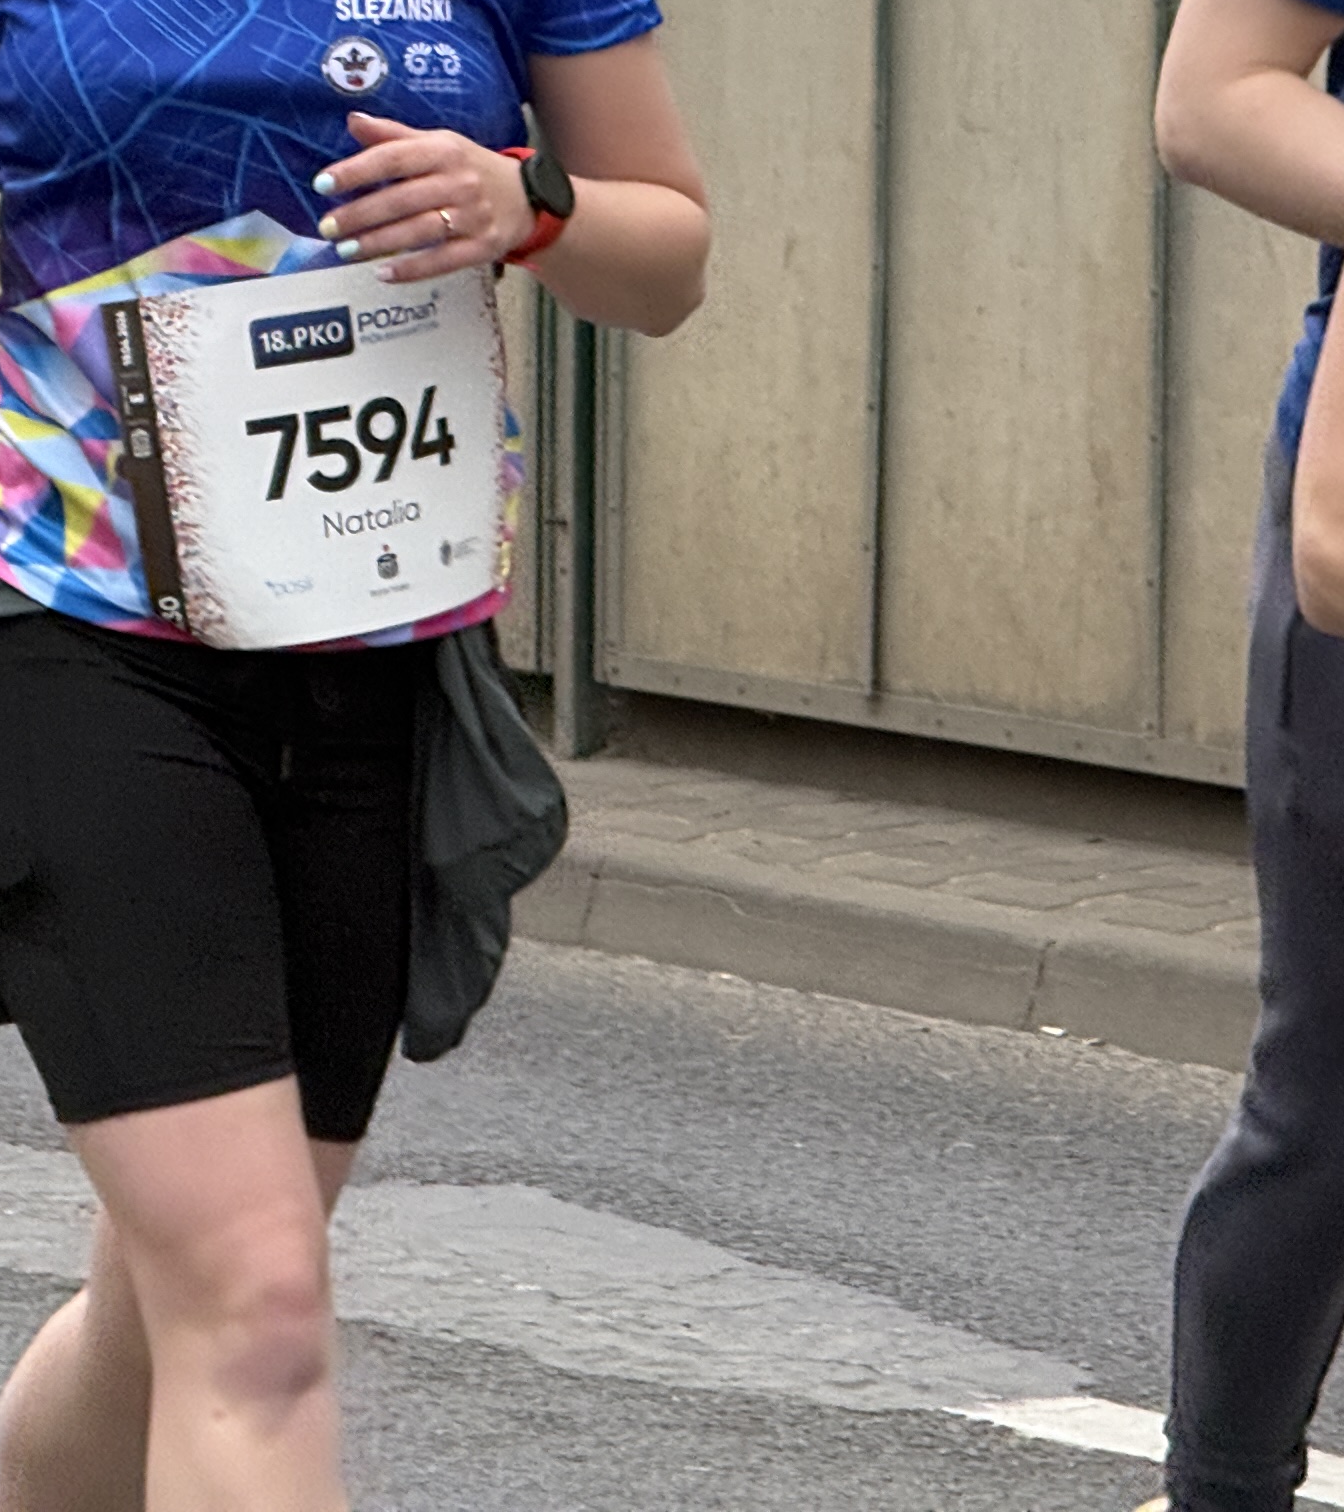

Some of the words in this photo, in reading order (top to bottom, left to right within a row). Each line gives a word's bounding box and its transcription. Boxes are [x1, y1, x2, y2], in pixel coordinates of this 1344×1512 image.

[259, 320, 346, 354] 18.PKO
[245, 384, 456, 502] 7594
[321, 499, 422, 539] Natalia
